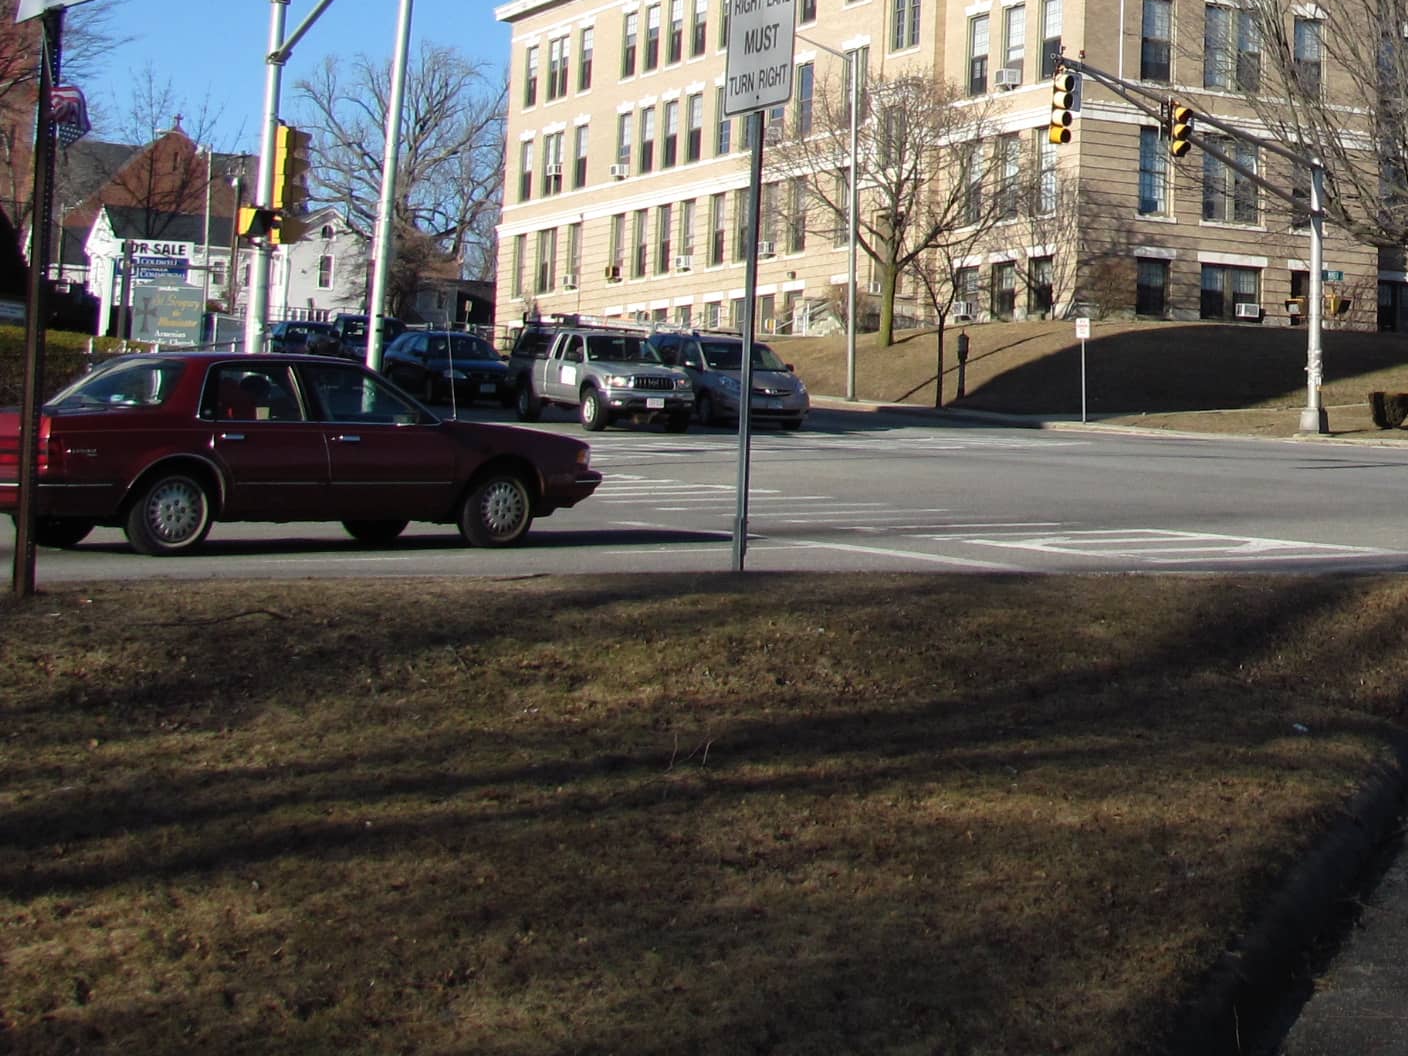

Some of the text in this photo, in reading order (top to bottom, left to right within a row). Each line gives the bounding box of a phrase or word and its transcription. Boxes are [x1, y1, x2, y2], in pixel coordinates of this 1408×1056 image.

[744, 23, 780, 56] MUST
[729, 64, 788, 96] TURN RIGHT
[154, 243, 186, 256] SALE
